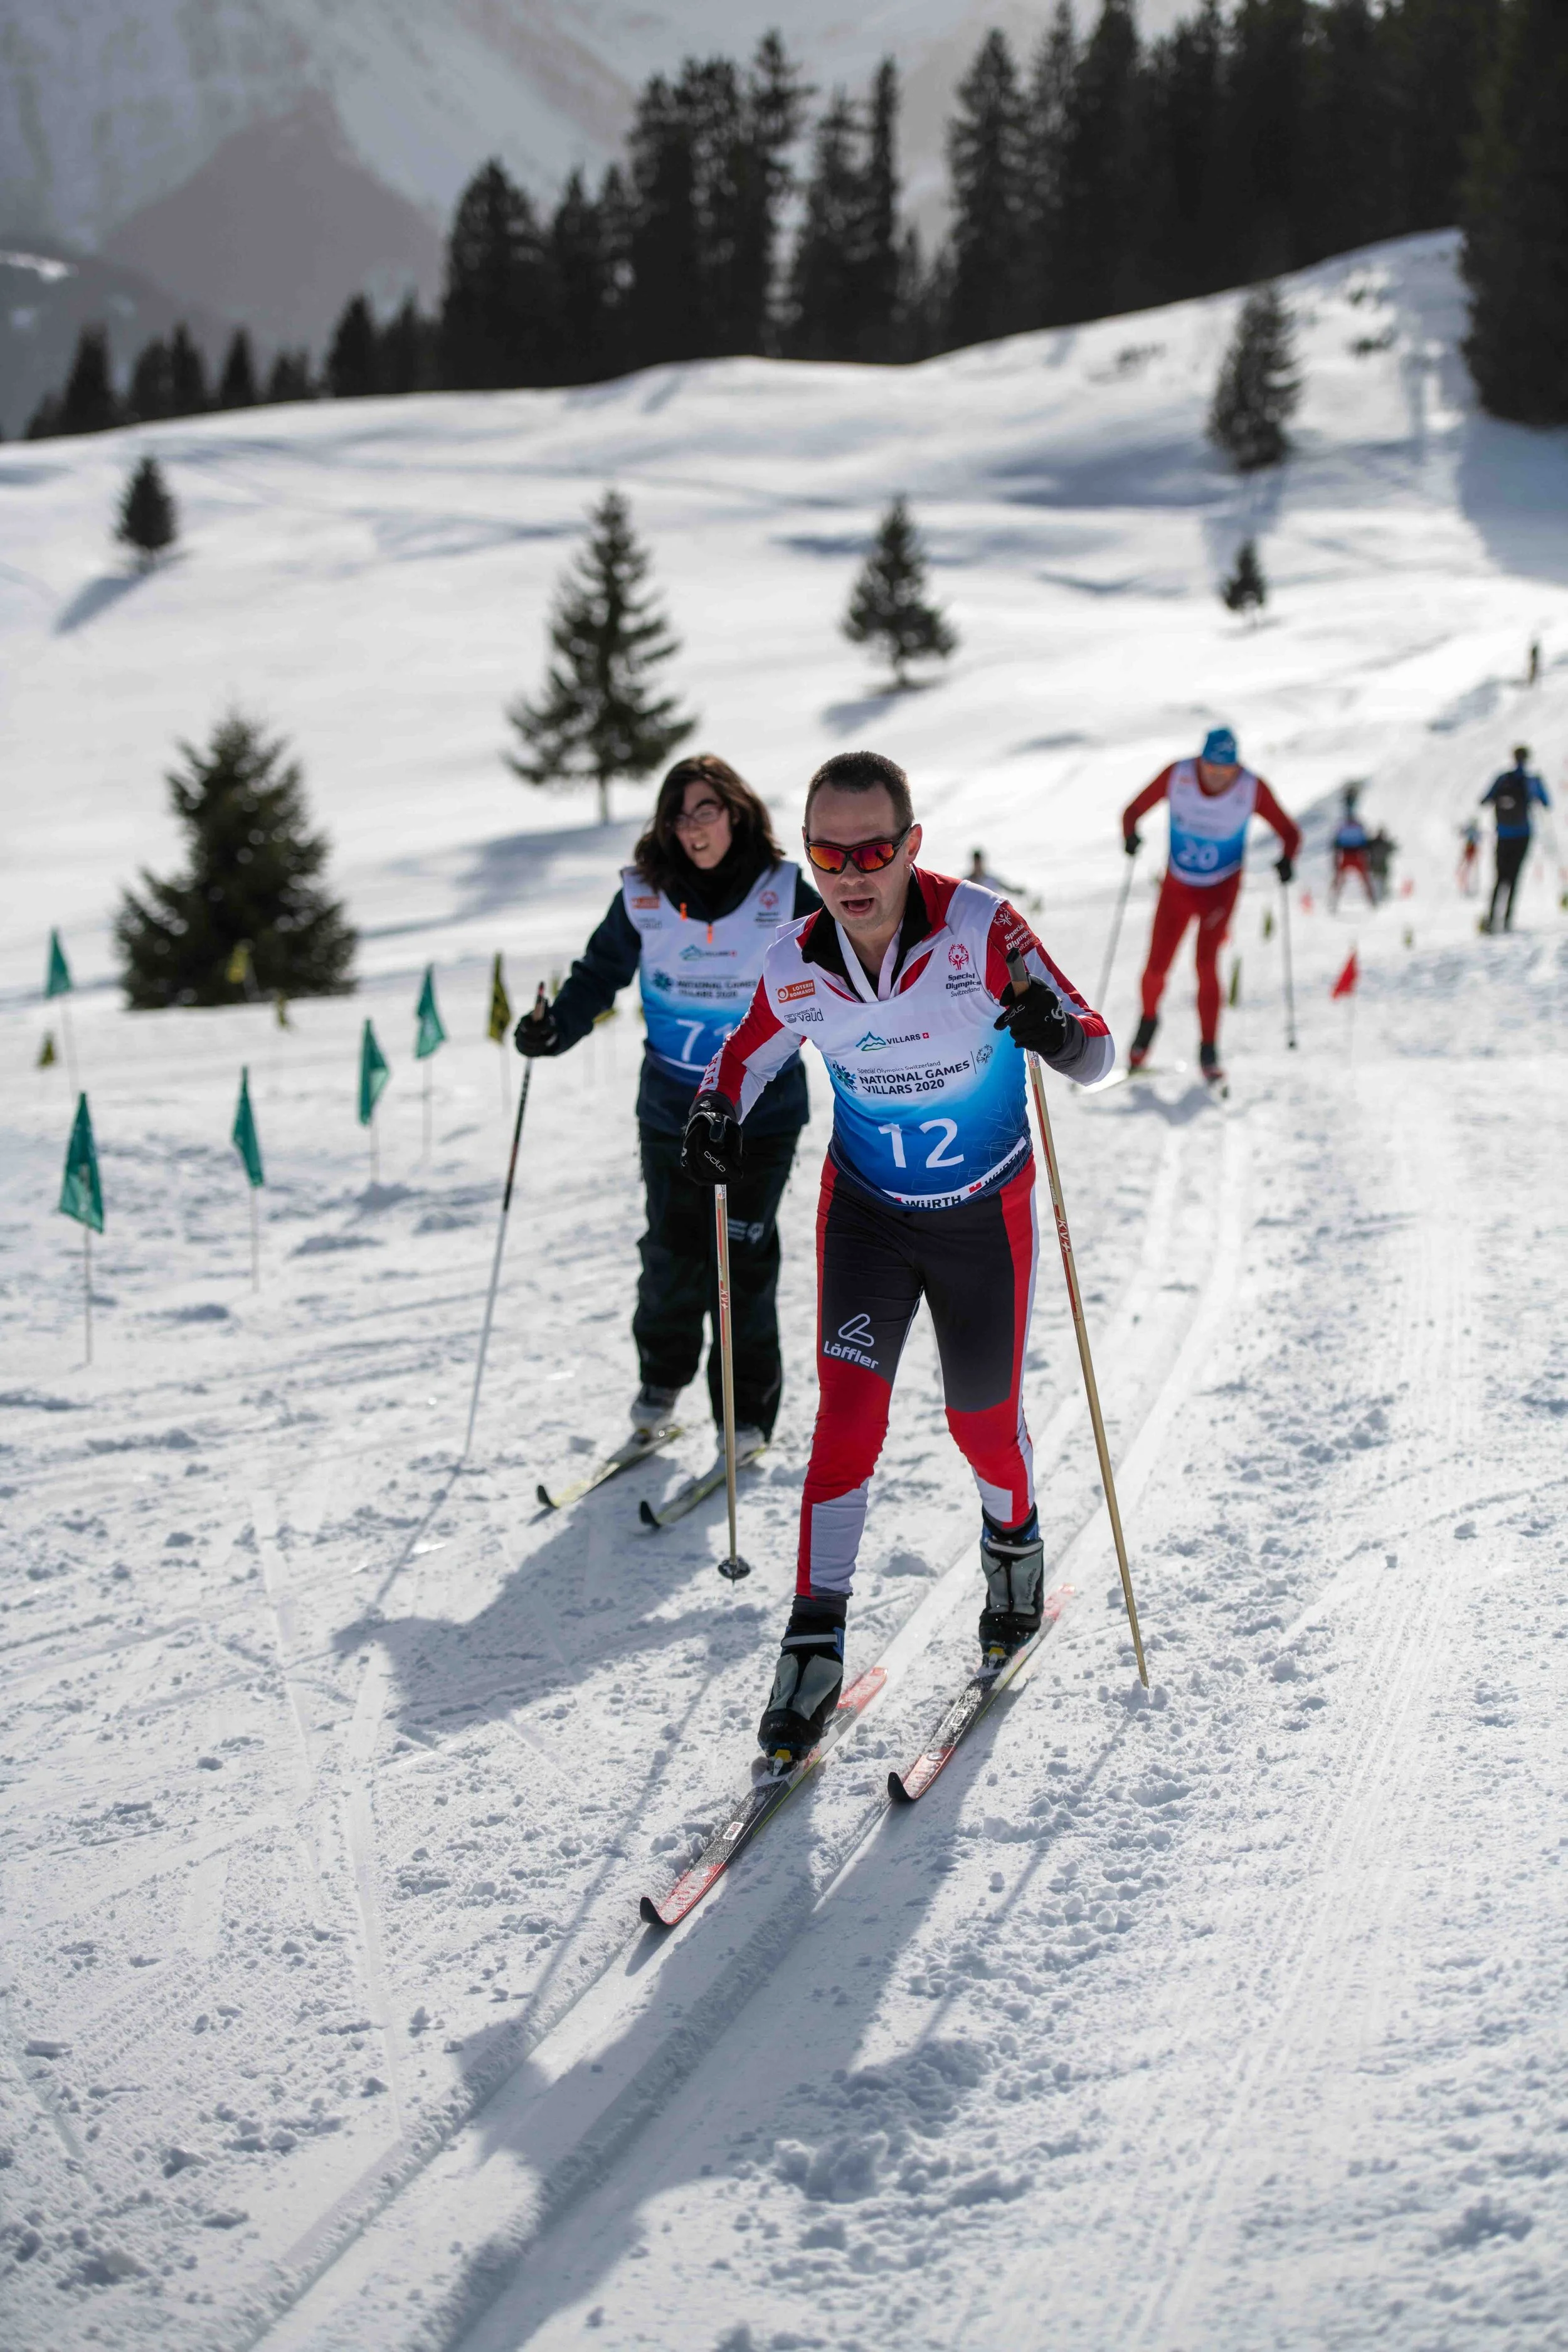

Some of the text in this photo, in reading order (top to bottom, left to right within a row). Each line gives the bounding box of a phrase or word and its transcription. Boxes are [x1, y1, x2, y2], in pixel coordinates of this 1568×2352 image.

[1004, 923, 1025, 941] Special
[948, 972, 975, 982] Special
[792, 982, 813, 992] LOTERIE
[945, 980, 982, 990] Olympics
[950, 987, 980, 997] Switzerland
[790, 988, 814, 998] ROMANDE
[797, 1008, 824, 1022] vaud
[886, 1034, 921, 1044] VILLARS
[859, 1060, 970, 1084] NATIONAL GAMES
[904, 1060, 941, 1070] Switzerland
[862, 1079, 945, 1094] VILLARS 2020
[878, 1118, 965, 1168] 12
[704, 1150, 726, 1172] odlo
[906, 1195, 961, 1209] WÜRTH
[824, 1340, 879, 1369] Löffler
